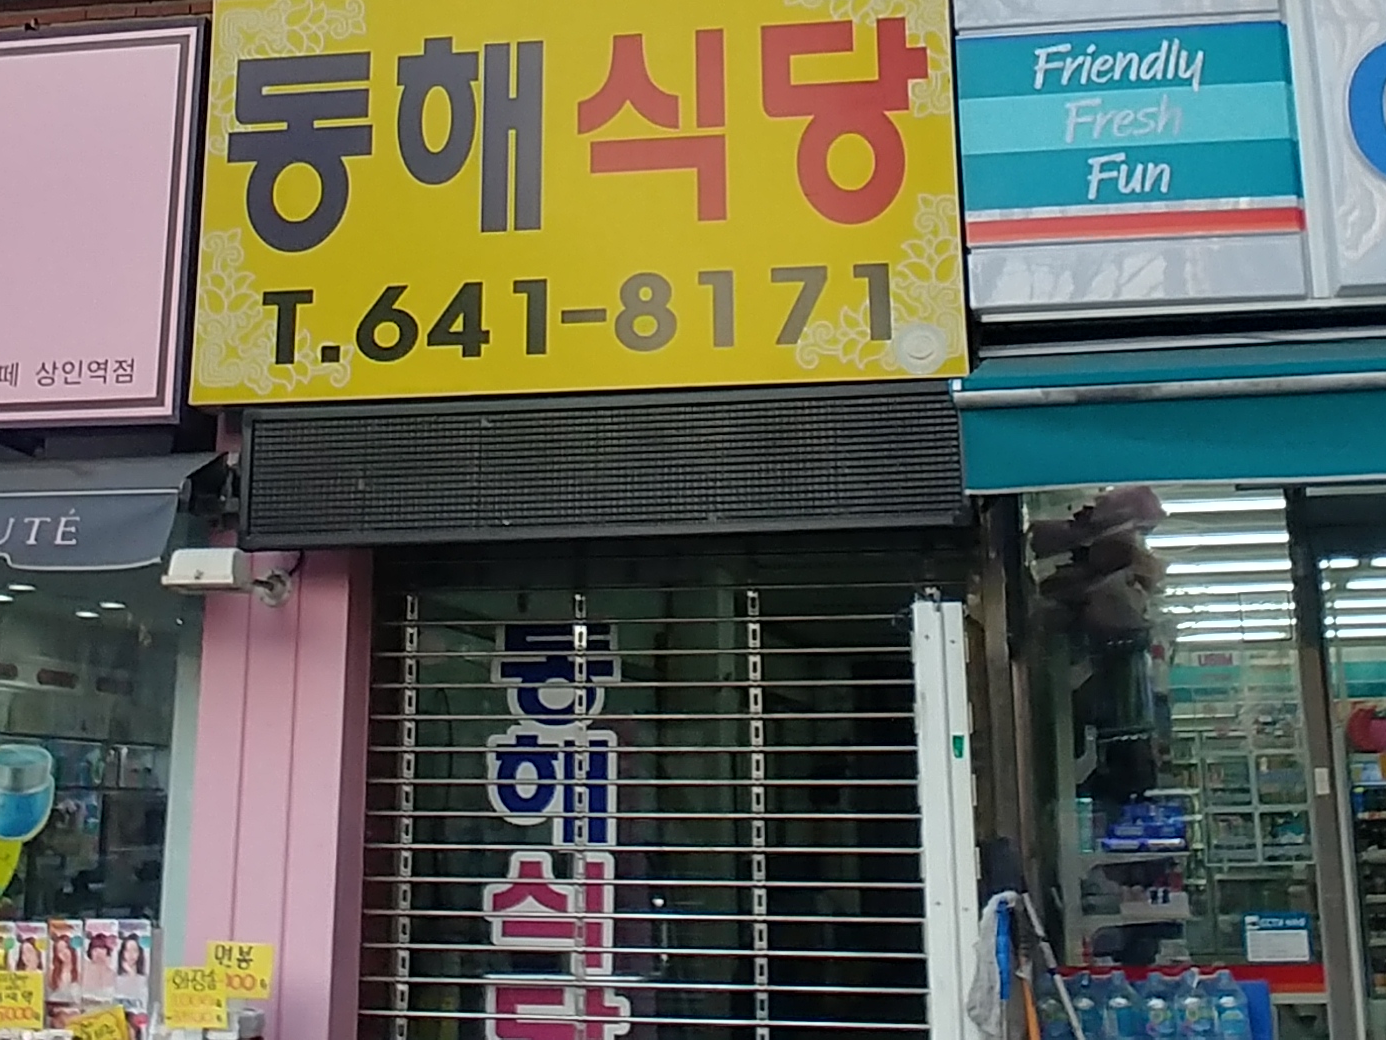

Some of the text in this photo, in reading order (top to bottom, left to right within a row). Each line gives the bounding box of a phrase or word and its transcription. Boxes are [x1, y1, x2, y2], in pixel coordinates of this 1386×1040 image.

[1033, 37, 1205, 92] Friendly
[226, 15, 930, 254] 동해식당
[1064, 94, 1183, 144] Fresh
[1087, 152, 1172, 200] Fun
[261, 262, 894, 365] T.641-8171
[34, 357, 137, 388] 상인역점
[214, 944, 254, 971] 면봉
